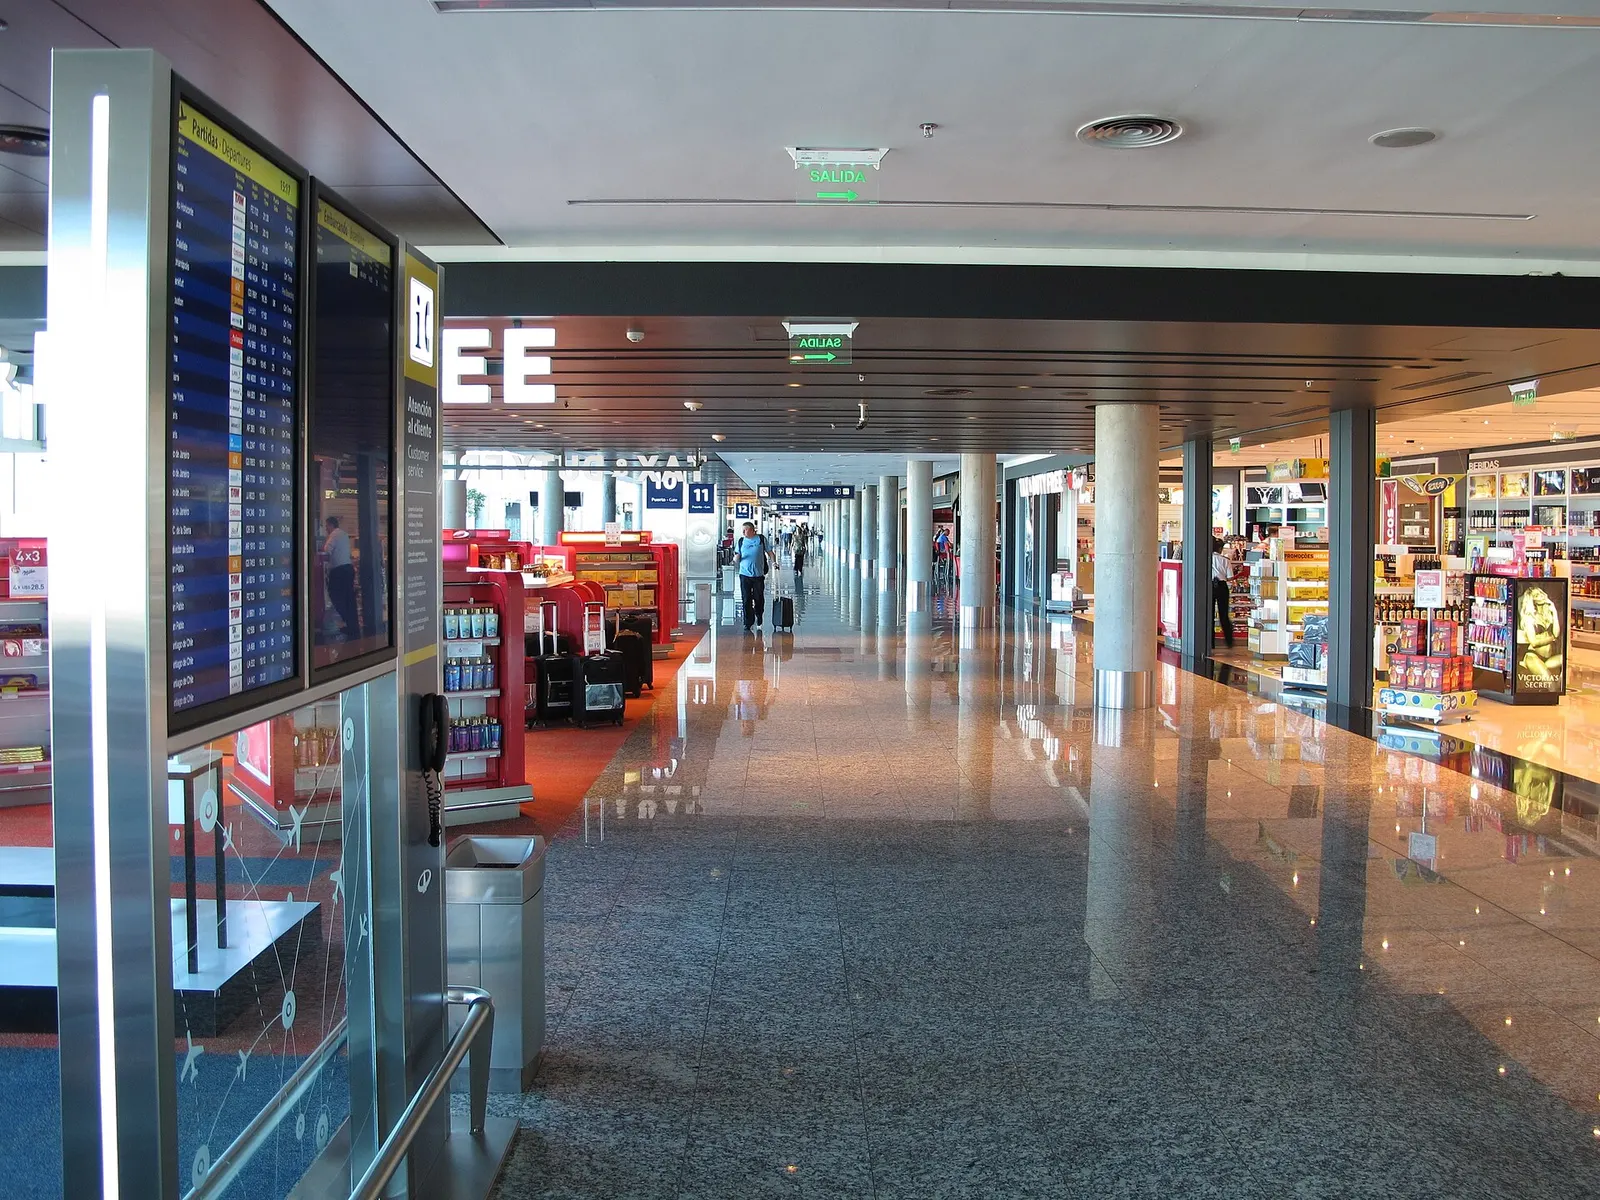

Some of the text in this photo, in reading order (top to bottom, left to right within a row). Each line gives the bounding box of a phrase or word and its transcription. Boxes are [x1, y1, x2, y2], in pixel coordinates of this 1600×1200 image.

[191, 118, 219, 151] Partidas
[221, 138, 252, 172] Departures
[810, 170, 866, 183] SALIDA
[407, 395, 432, 418] Atención
[407, 417, 432, 438] al cliente
[407, 444, 430, 461] Customer
[407, 463, 424, 478] service
[1468, 460, 1499, 472] BEBIDAS
[693, 488, 709, 502] 11
[737, 505, 748, 513] 12
[15, 550, 40, 562] 4x3
[1284, 551, 1314, 560] PROMOÇÕES
[1517, 673, 1560, 682] VICTORIA'S
[1524, 681, 1552, 689] SECRET
